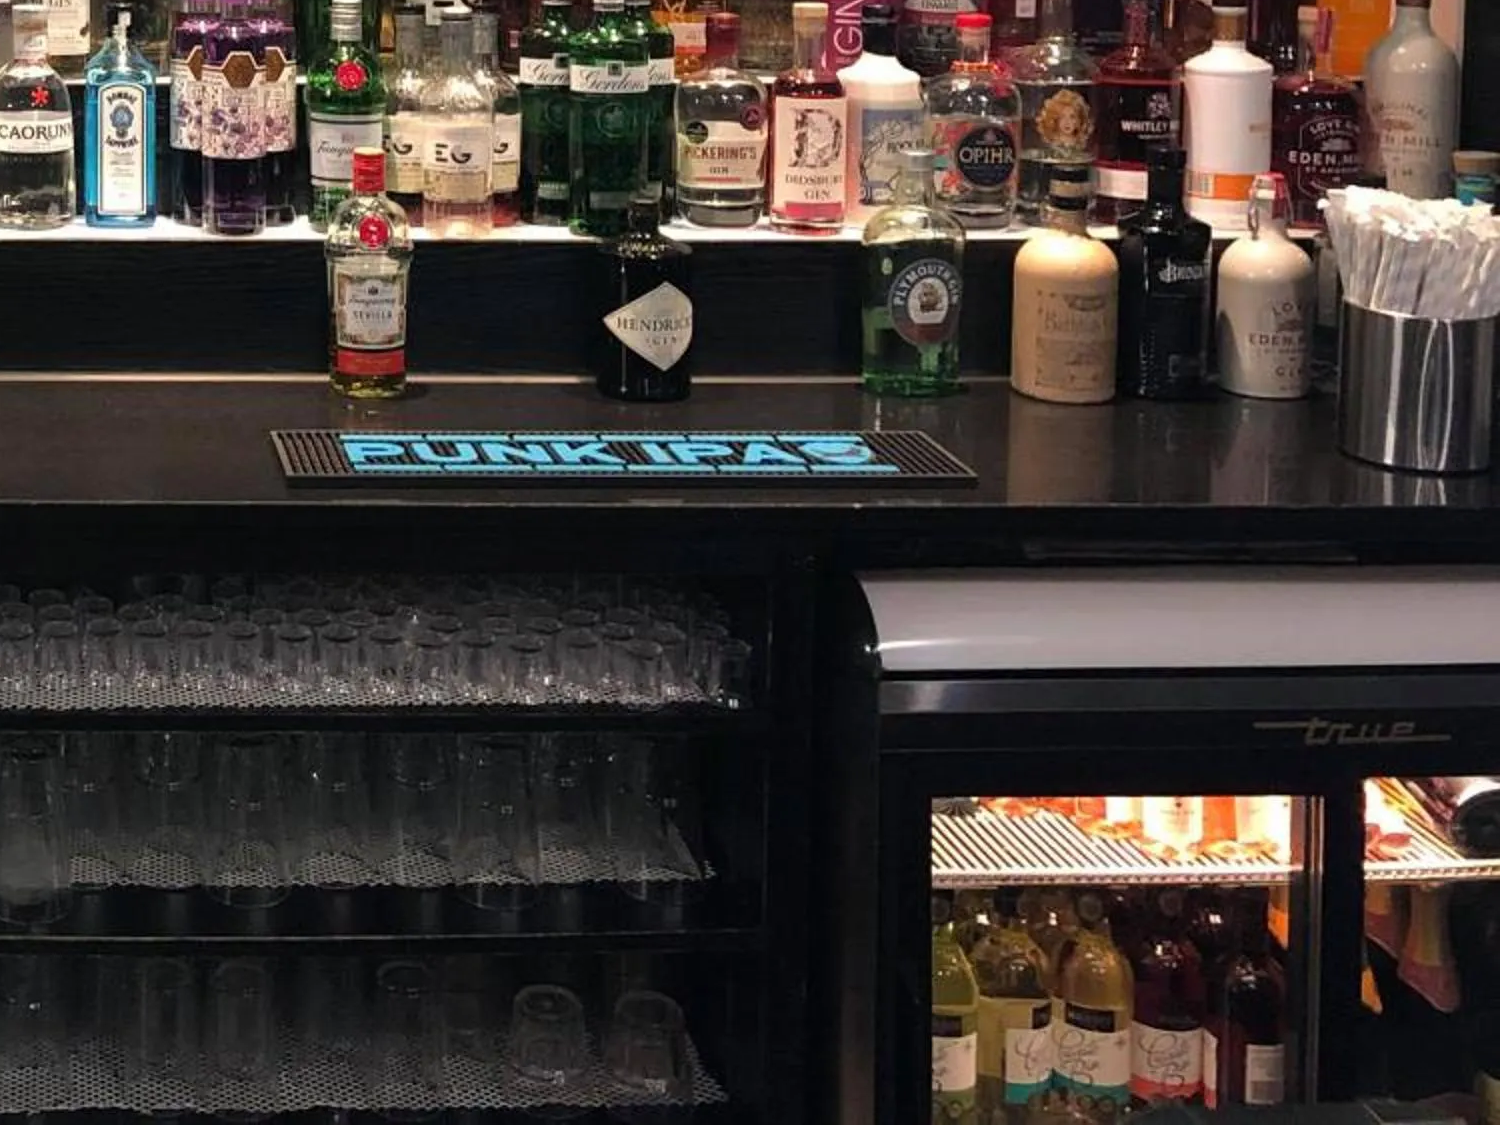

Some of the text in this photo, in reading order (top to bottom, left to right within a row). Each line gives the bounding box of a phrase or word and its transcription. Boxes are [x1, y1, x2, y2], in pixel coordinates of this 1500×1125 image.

[1121, 119, 1167, 132] WHITLEY
[435, 143, 472, 164] EG
[684, 146, 756, 160] PICKERING'S
[959, 147, 1014, 164] OPIHR
[894, 262, 951, 306] PLYMOUTH
[344, 441, 794, 465] PUNK IPA
